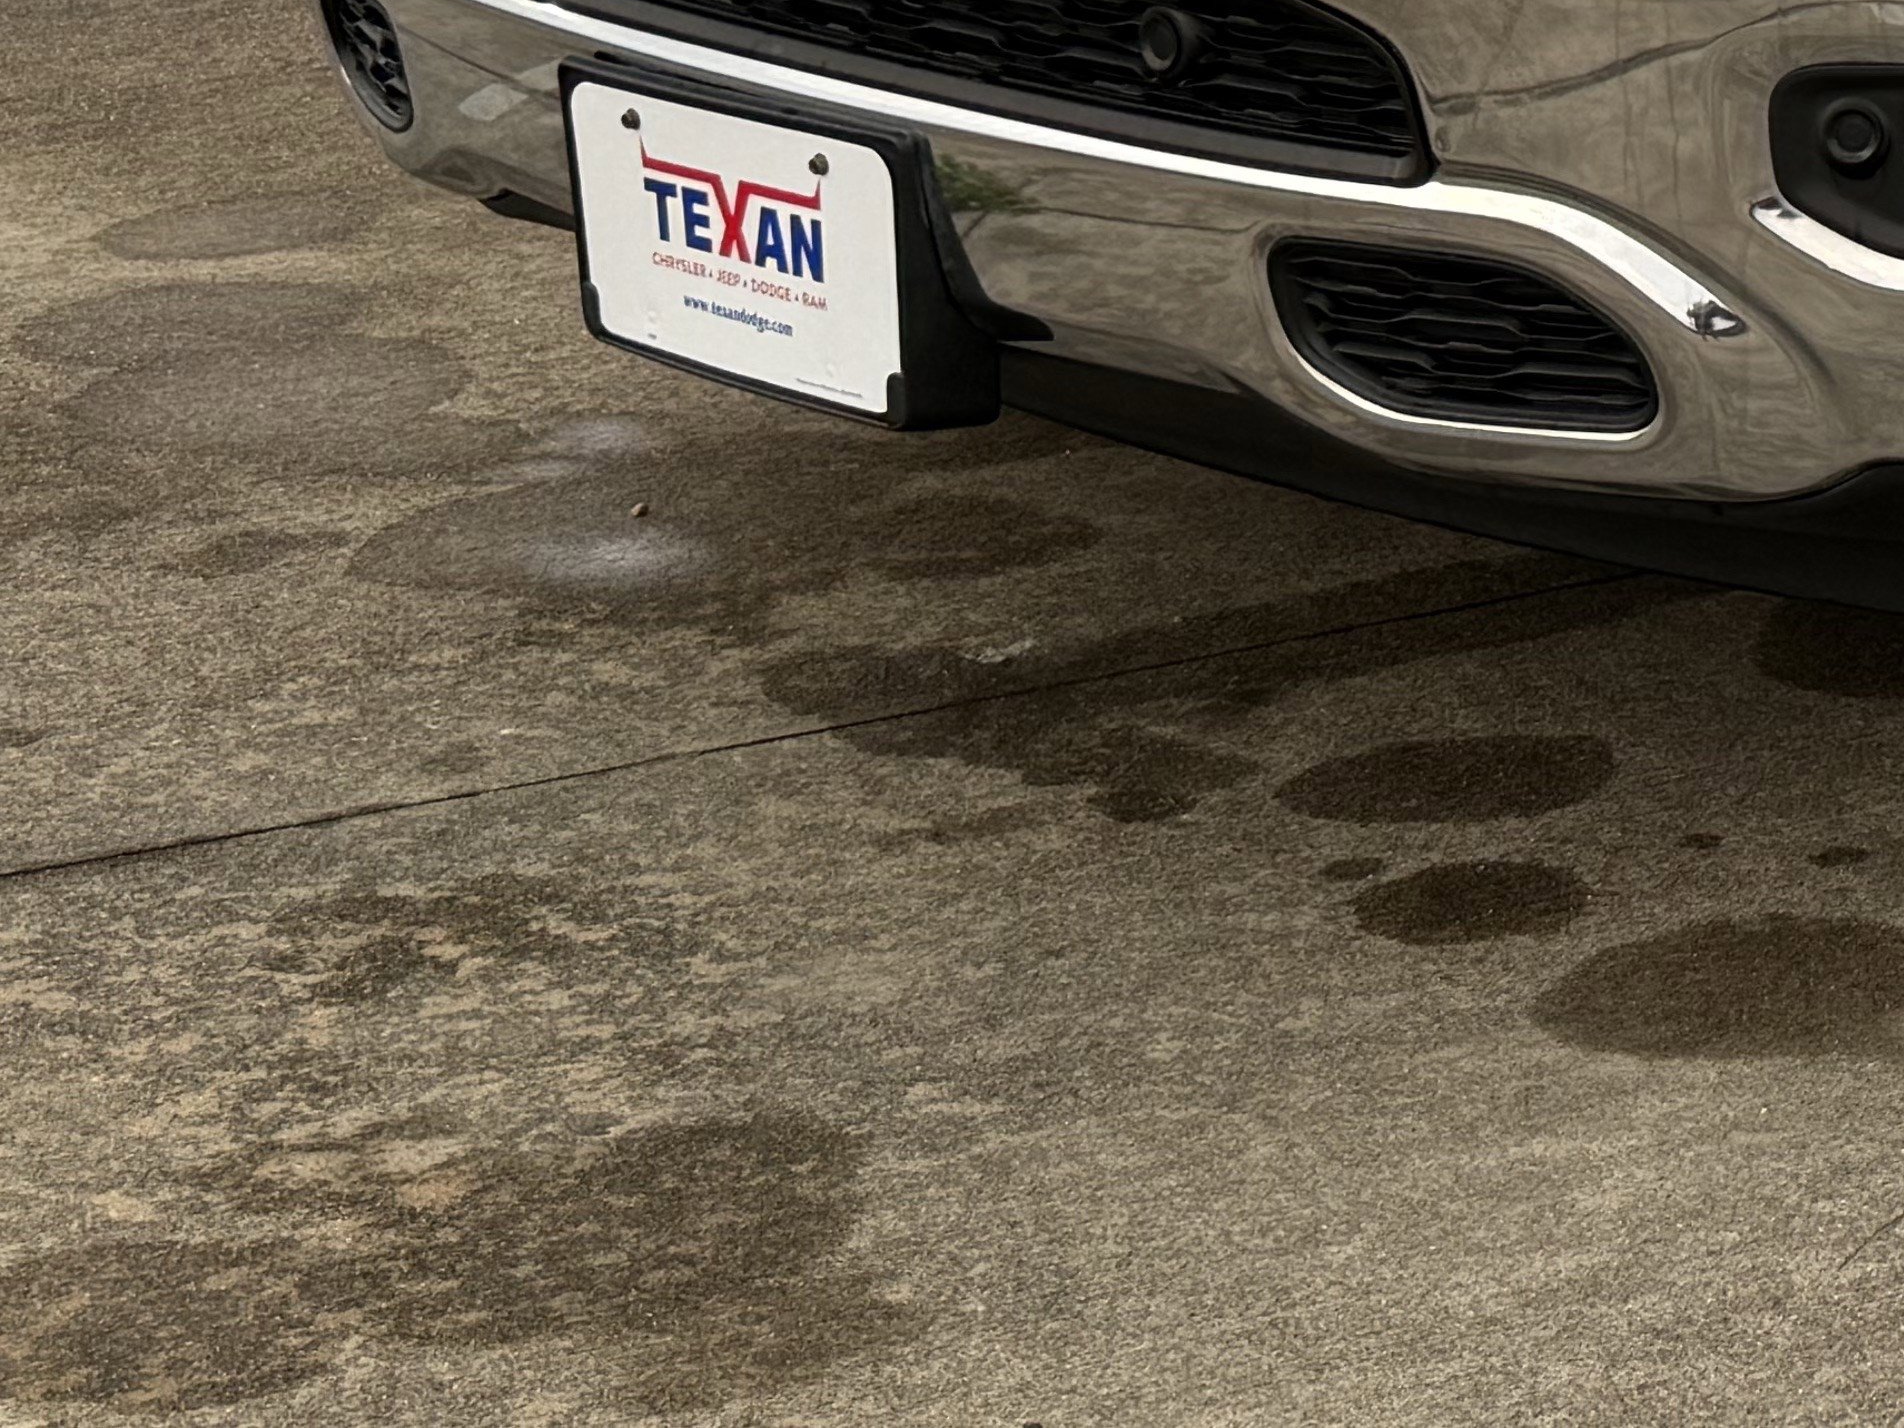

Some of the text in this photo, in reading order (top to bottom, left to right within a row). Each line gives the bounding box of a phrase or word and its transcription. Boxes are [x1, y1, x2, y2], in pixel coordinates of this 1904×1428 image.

[641, 135, 825, 283] TEXAN
[652, 251, 828, 311] CHRYSLER JEEP DODGE RAM
[683, 294, 793, 337] www.texandodge.com
